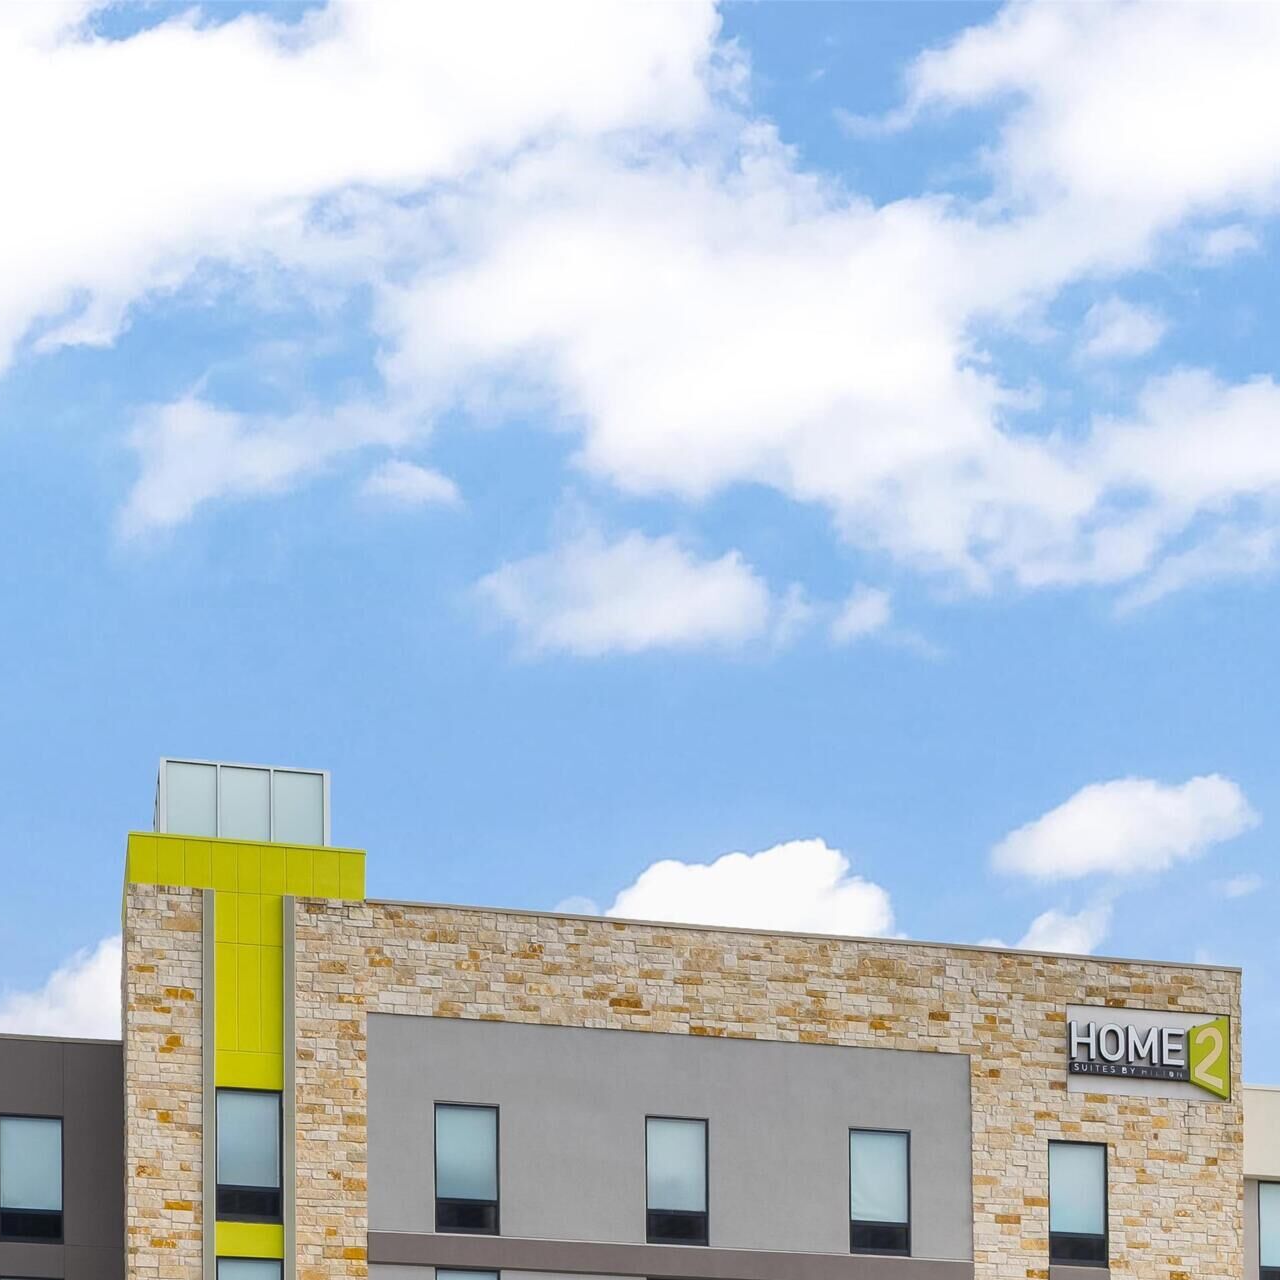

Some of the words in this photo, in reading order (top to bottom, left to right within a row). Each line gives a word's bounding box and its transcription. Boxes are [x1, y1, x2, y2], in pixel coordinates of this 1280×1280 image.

[1070, 1020, 1185, 1066] HOME
[1194, 1026, 1224, 1090] 2
[1074, 1063, 1116, 1074] SUITES
[1121, 1066, 1136, 1075] BY
